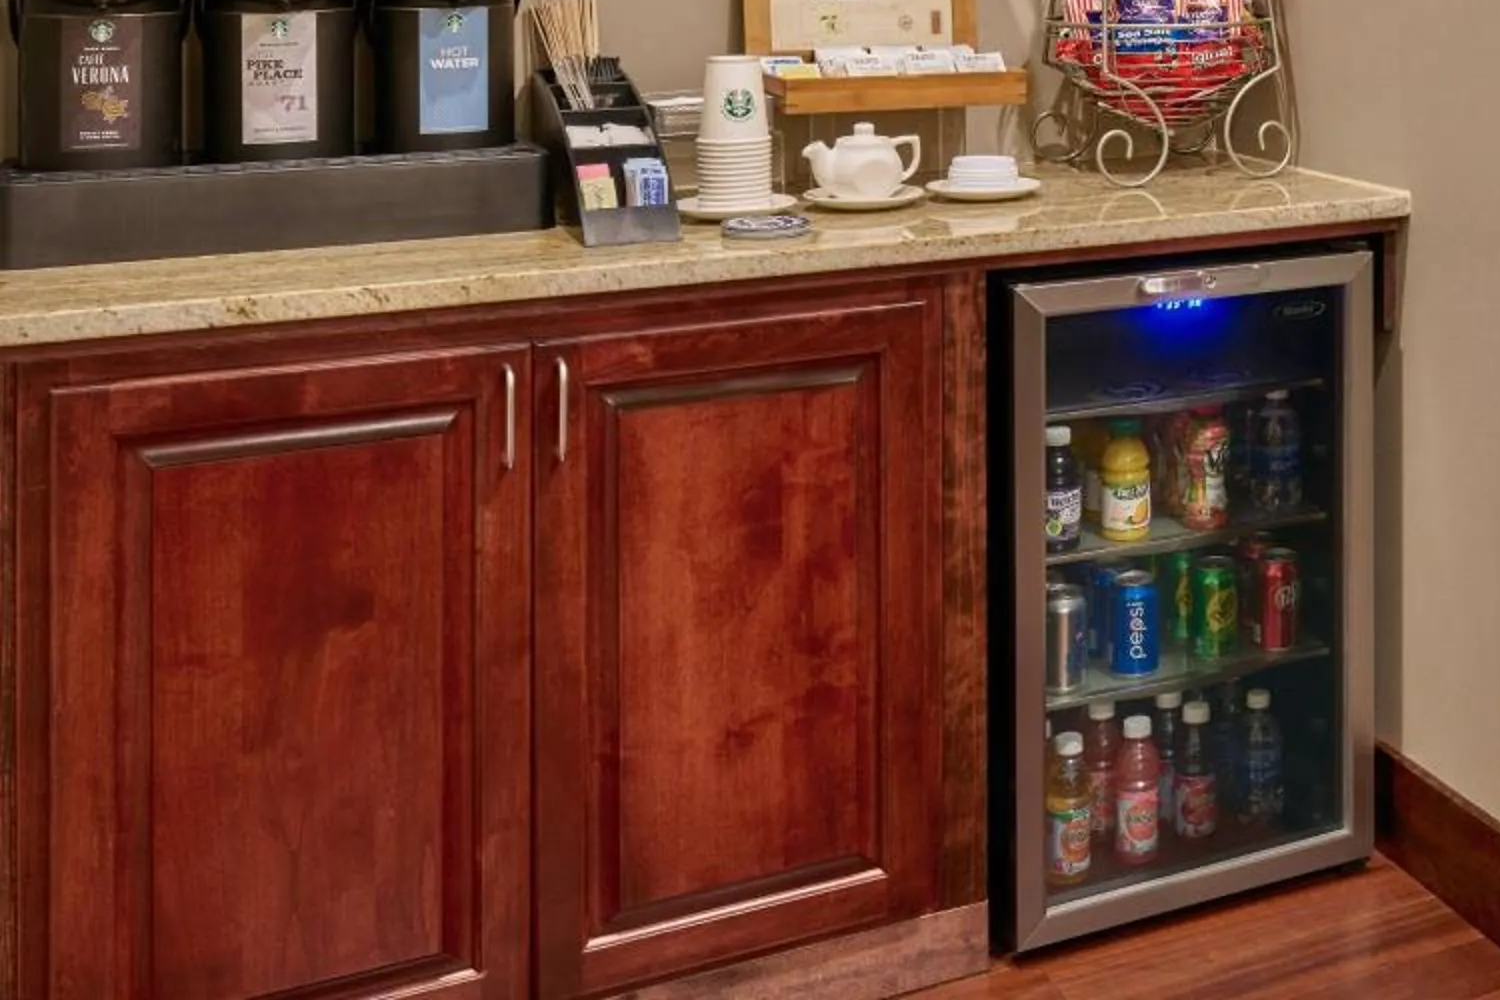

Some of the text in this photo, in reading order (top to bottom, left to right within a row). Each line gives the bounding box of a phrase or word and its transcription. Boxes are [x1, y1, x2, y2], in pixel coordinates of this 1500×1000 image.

[440, 45, 469, 57] HOT
[246, 59, 284, 70] PIKE
[430, 57, 480, 69] WATER
[72, 65, 129, 85] VERONA
[253, 69, 303, 80] PLACE
[1126, 601, 1148, 660] pepsi
